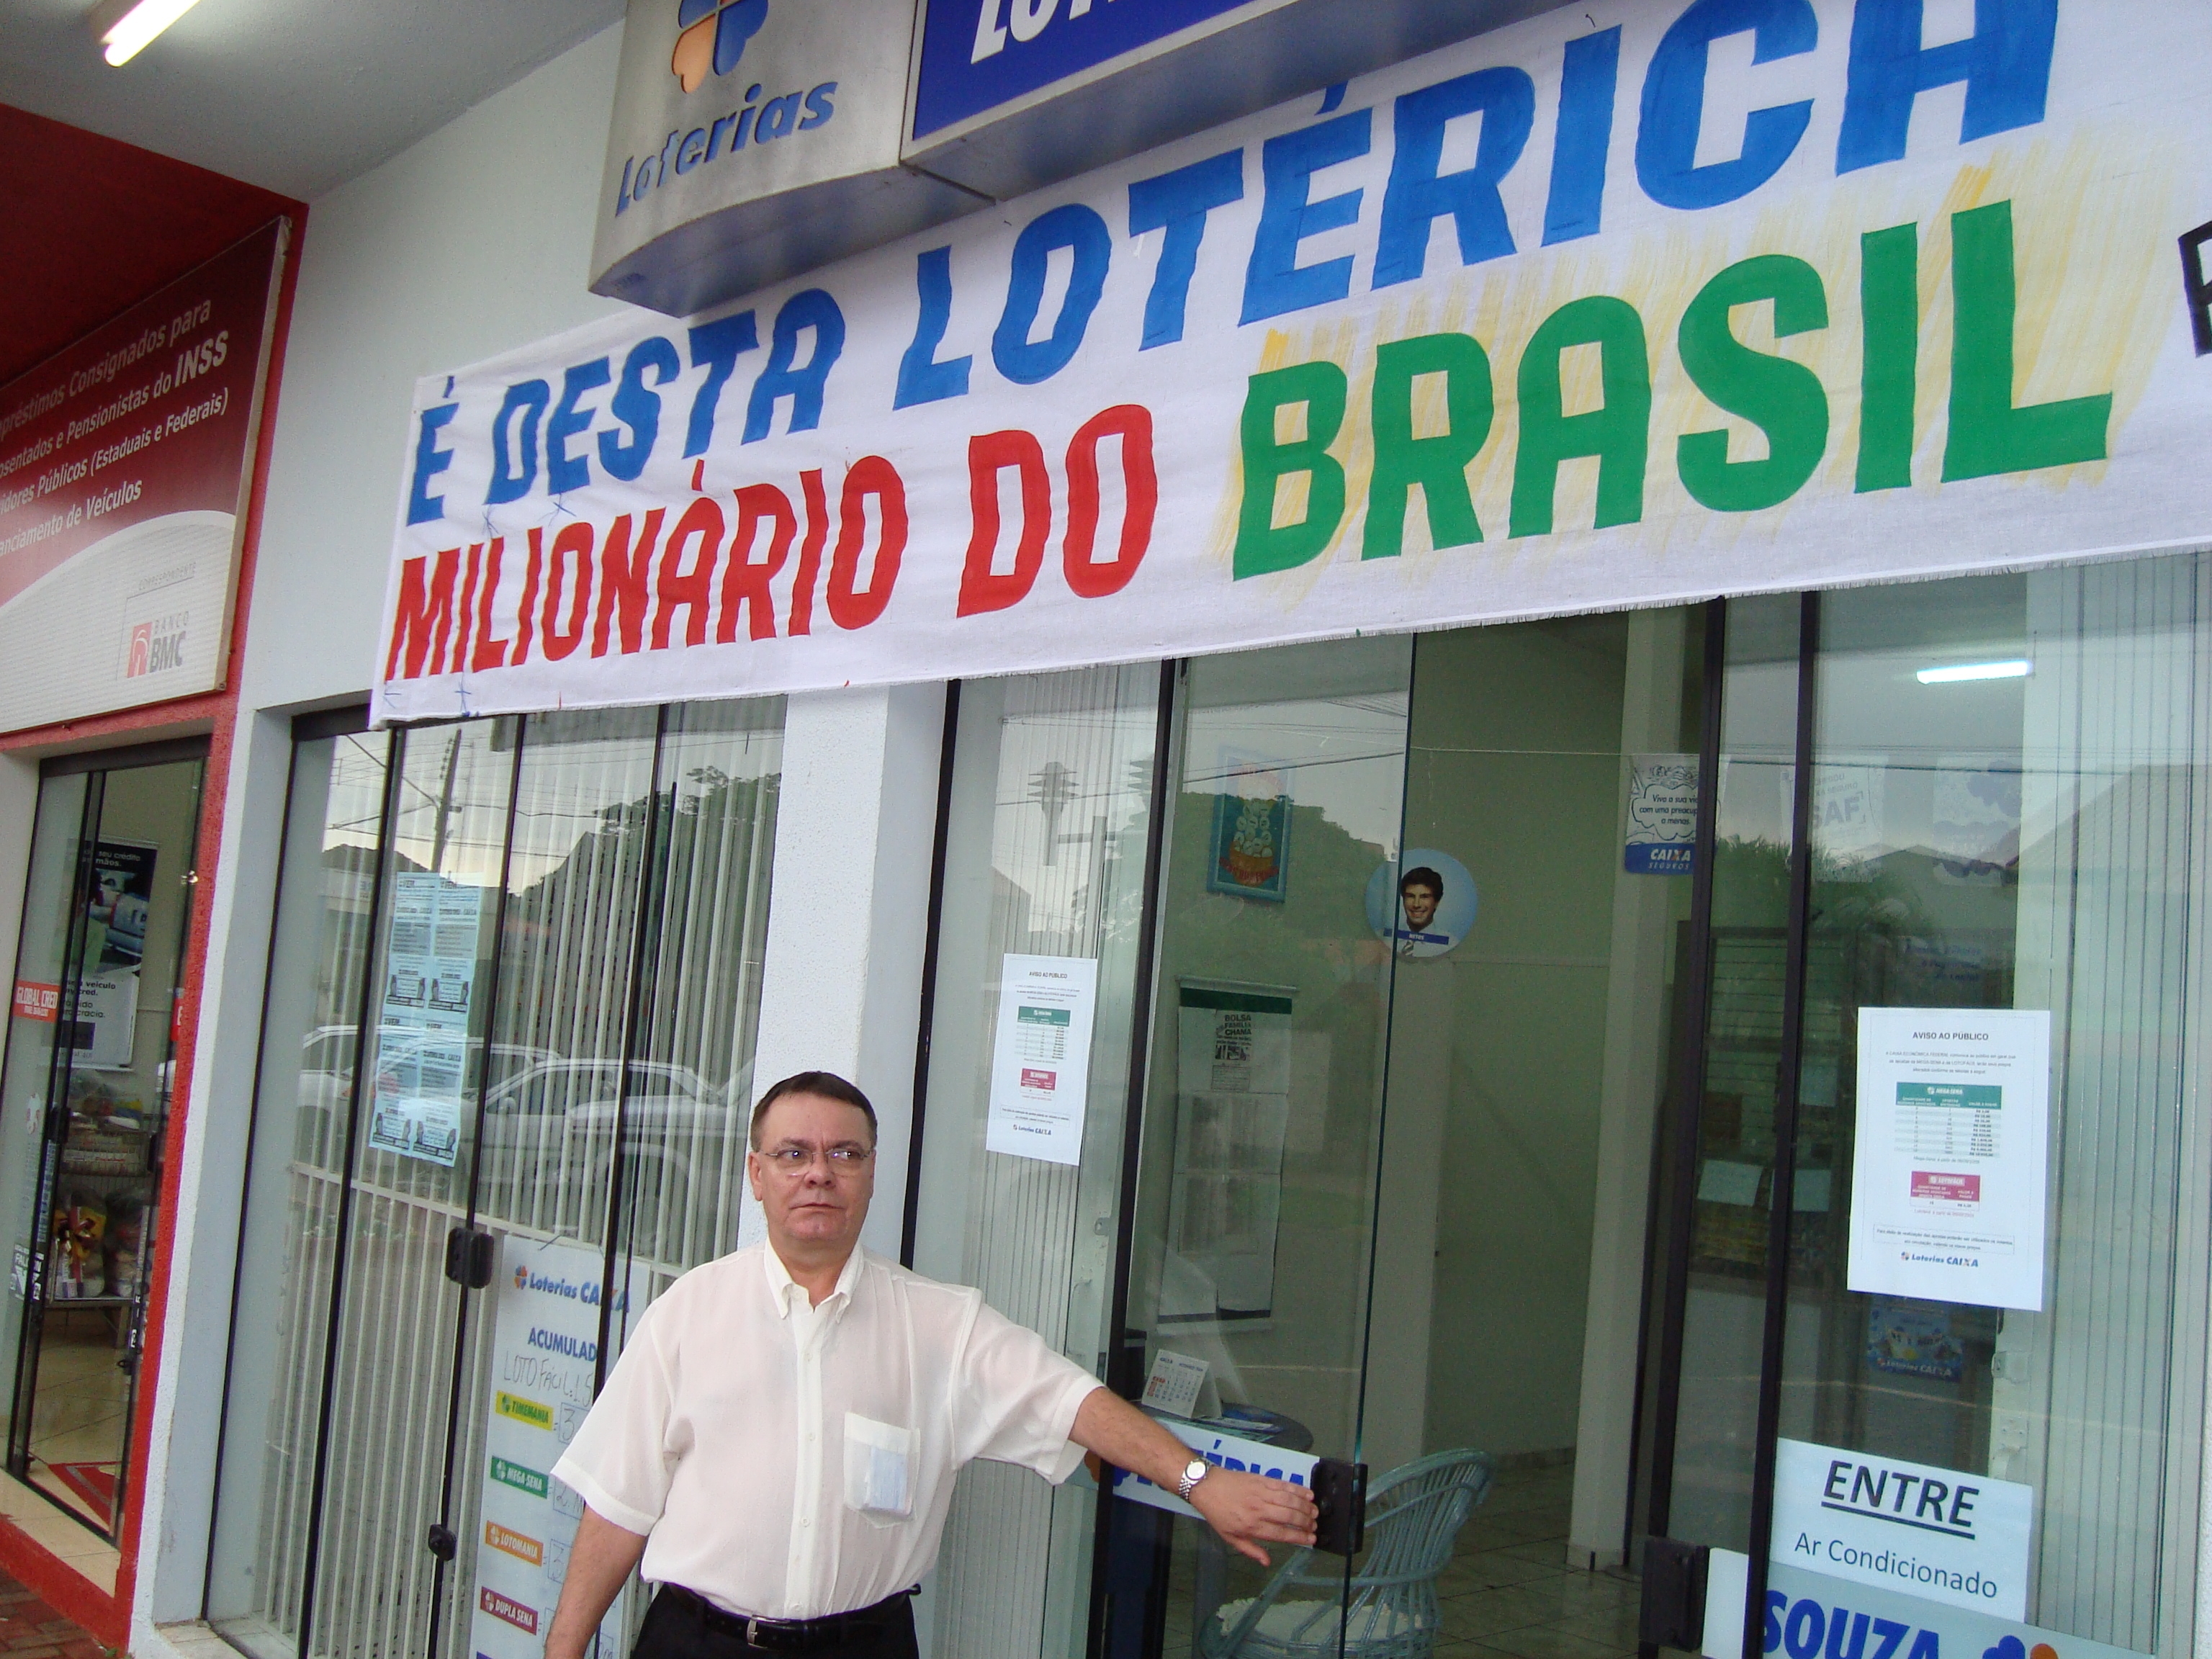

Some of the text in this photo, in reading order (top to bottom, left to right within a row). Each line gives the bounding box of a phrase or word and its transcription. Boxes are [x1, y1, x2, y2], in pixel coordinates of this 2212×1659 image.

[616, 81, 837, 217] Loterias
[406, 375, 459, 526] É
[485, 289, 845, 505] DESTA
[893, 0, 2059, 410] LOTÉRICA
[0, 300, 211, 442] préstimos Consignados para
[56, 432, 63, 449] e
[66, 385, 149, 444] Pensionistas
[153, 372, 171, 398] do
[174, 330, 229, 388] INSS
[37, 457, 88, 498] Públicos
[91, 428, 151, 477] (Estaduais
[154, 424, 163, 442] e
[166, 387, 228, 437] Federais)
[385, 456, 908, 681] MILIONÁRIO
[957, 404, 1157, 619] DO
[1233, 199, 2113, 582] BRASIL
[66, 504, 82, 530] de
[86, 479, 143, 521] Veículos
[150, 631, 186, 673] BMC
[1650, 848, 1691, 861] CAIXA
[1952, 1030, 1989, 1041] PÚBLICO
[1912, 1254, 1979, 1267] Loterias CAIXA
[529, 1272, 629, 1313] Loterias CAA
[528, 1327, 597, 1362] ACUMULAD
[1823, 1460, 1980, 1528] ENTRE
[500, 1533, 538, 1560] LOTOMANIA
[1794, 1532, 1997, 1599] Ar Condicionado
[495, 1599, 533, 1627] DUPLA SENA
